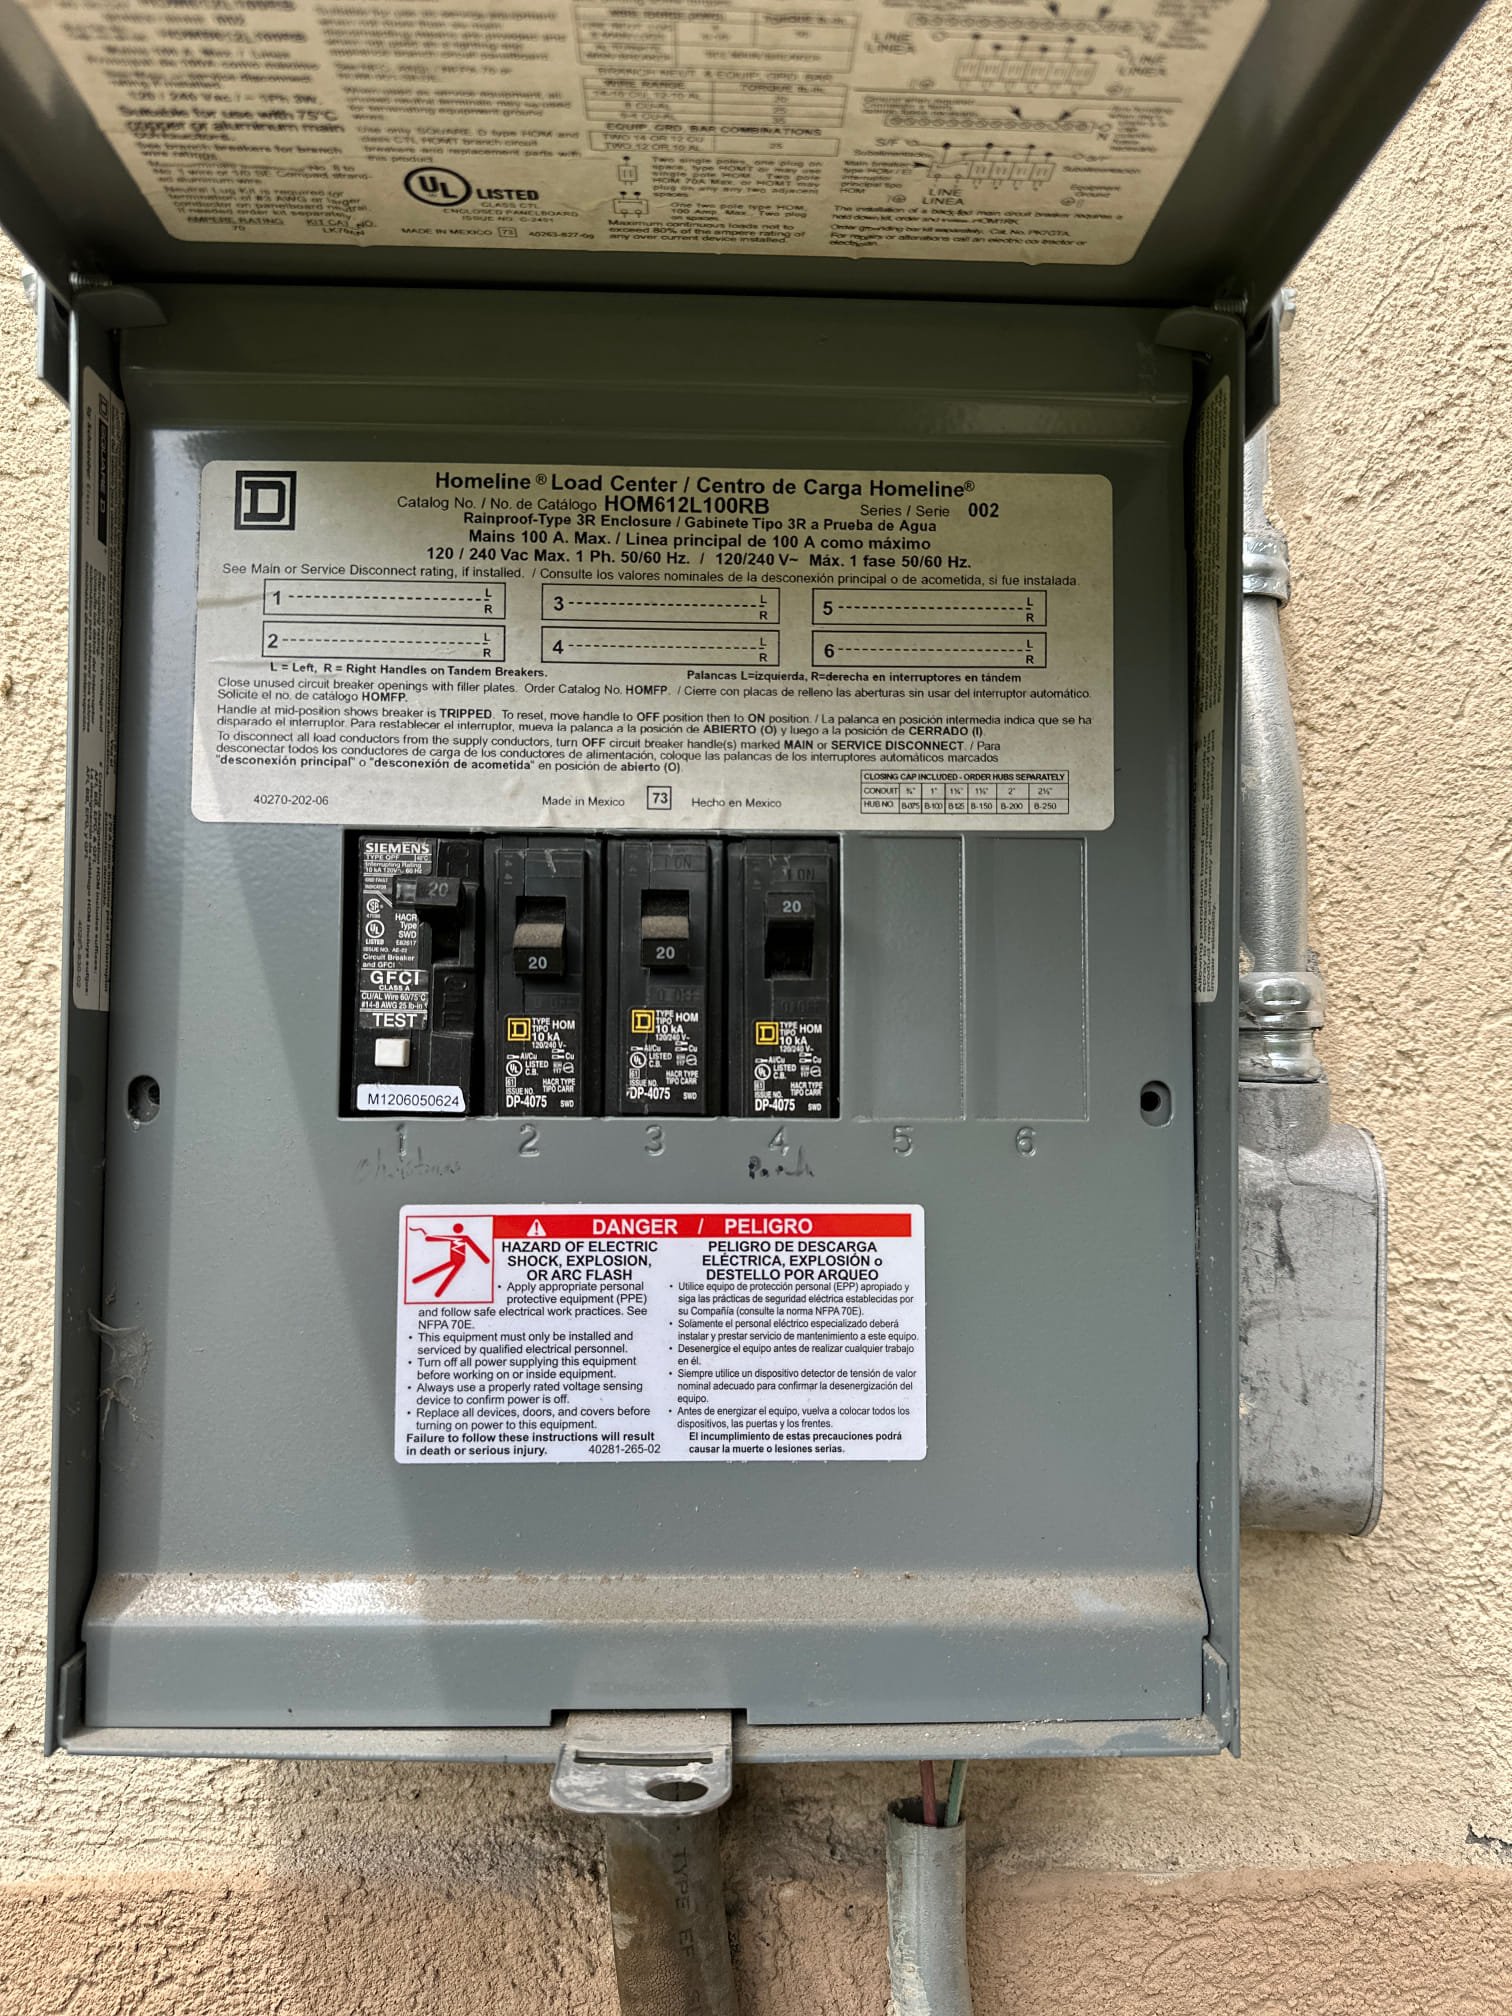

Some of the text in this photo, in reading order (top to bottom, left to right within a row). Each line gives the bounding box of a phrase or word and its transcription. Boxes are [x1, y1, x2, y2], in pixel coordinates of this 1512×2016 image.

[476, 189, 539, 201] LISTED
[928, 188, 962, 197] LINE
[551, 473, 602, 491] Load
[610, 475, 678, 492] Center
[696, 476, 765, 494] Centro
[772, 478, 796, 495] de
[803, 478, 862, 498] Carga
[396, 495, 449, 511] Catalog
[454, 497, 476, 509] No.
[490, 497, 512, 510] No.
[515, 498, 533, 510] de
[537, 498, 597, 515] Catálogo
[604, 495, 770, 515] HOM612L100RB
[859, 504, 902, 516] Series
[915, 505, 950, 517] Serie
[968, 502, 999, 518] 002
[469, 529, 515, 543] Mains
[521, 530, 548, 543] 100
[552, 530, 568, 544] A.
[574, 531, 611, 545] Max.
[673, 533, 742, 549] principal
[747, 534, 767, 547] de
[772, 535, 798, 548] 100
[803, 535, 815, 548] A
[820, 538, 864, 549] como
[868, 536, 931, 550] máximo
[426, 546, 454, 560] 120
[469, 547, 496, 560] 240
[500, 548, 528, 561] Vac
[534, 548, 570, 562] Max.
[576, 550, 582, 562] 1
[590, 550, 615, 563] Ph.
[620, 550, 661, 564] 50/60
[666, 551, 690, 564] Hz.
[715, 552, 775, 566] 120/240
[778, 553, 799, 566] V~
[809, 553, 844, 567] Máx.
[849, 555, 856, 567] 1
[862, 555, 896, 567] fase
[901, 555, 942, 568] 50/60
[947, 555, 971, 568] Hz.
[272, 590, 281, 605] 1
[554, 596, 565, 611] 3
[822, 601, 834, 616] 5
[267, 634, 279, 649] 2
[552, 640, 564, 655] 4
[824, 644, 835, 658] 6
[253, 794, 329, 805] 40270-202-06
[542, 795, 625, 807] Made in Mexico
[652, 792, 668, 804] 73
[691, 797, 782, 808] Hecho en Mexico
[365, 842, 430, 854] SIEMENS
[428, 882, 449, 897] 20
[782, 900, 802, 913] 20
[395, 913, 418, 921] HACR
[400, 922, 417, 930] Type
[398, 930, 417, 939] SWD
[388, 954, 415, 962] Breaker
[656, 946, 676, 960] 20
[528, 956, 548, 970] 20
[370, 970, 420, 985] GFCI
[372, 1013, 418, 1028] TEST
[676, 1012, 699, 1022] HOM
[552, 1020, 576, 1030] HOM
[656, 1025, 684, 1033] 10 kA
[800, 1024, 823, 1034] HOM
[532, 1032, 560, 1041] 10 kA
[780, 1036, 808, 1045] 10 kA
[368, 1094, 459, 1107] M1206050624
[630, 1088, 671, 1100] DP-4075
[506, 1096, 547, 1108] DP-4075
[560, 1100, 575, 1108] SWD
[754, 1099, 796, 1111] DP-4075
[396, 1123, 407, 1159] 1
[518, 1123, 540, 1158] 2
[645, 1124, 665, 1157] 3
[768, 1124, 790, 1157] 4
[893, 1125, 914, 1157] 5
[1016, 1126, 1037, 1158] 6
[592, 1218, 678, 1235] DANGER
[725, 1218, 813, 1234] PELIGRO
[501, 1240, 658, 1253] HAZARD OF ELECTRIC
[708, 1240, 878, 1254] PELIGRO DE DESCARGA
[507, 1254, 652, 1268] SHOCK, EXPLOSION,
[702, 1254, 883, 1268] ELÉCTRICA, EXPLOSIÓN o
[526, 1269, 632, 1281] OR ARC FLASH
[706, 1268, 879, 1281] DESTELLO POR ARQUEO
[406, 1431, 655, 1443] Failure to follow these instructions will result
[406, 1445, 547, 1457] in death or serious injury.
[588, 1443, 661, 1454] 40281-265-02
